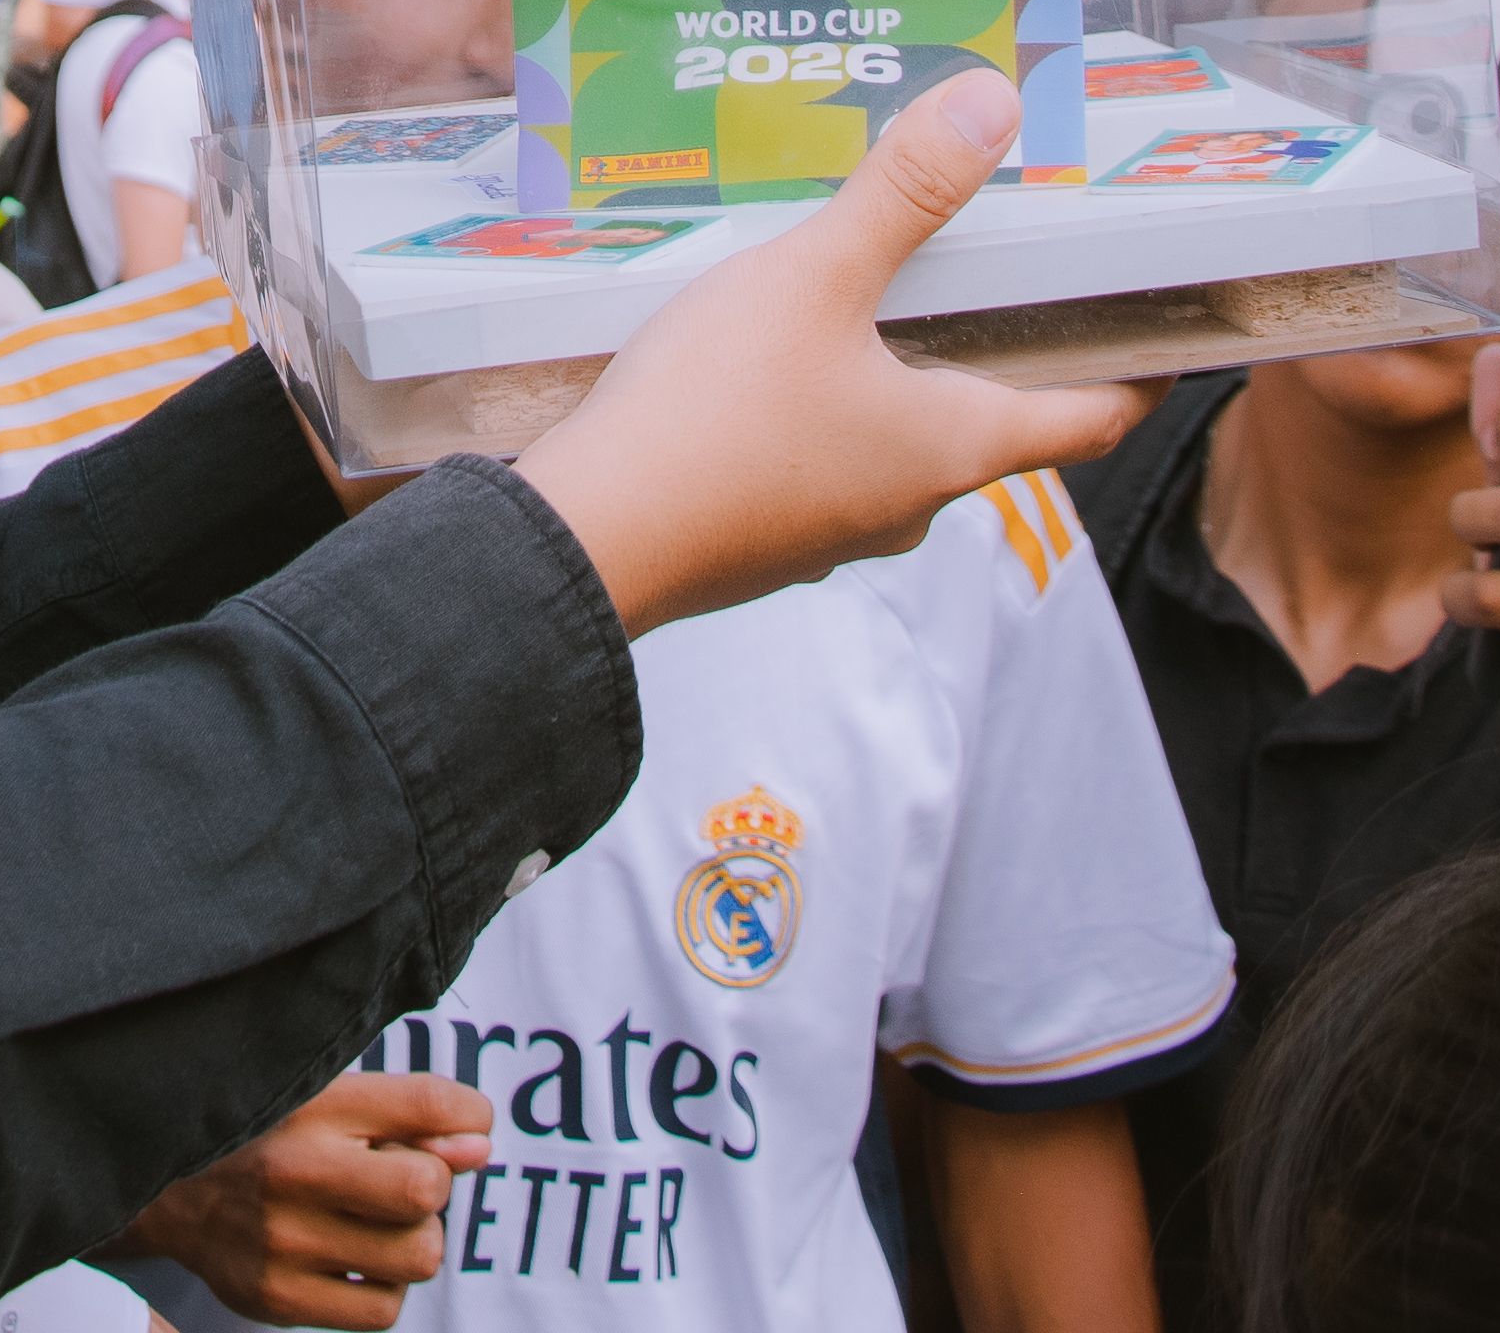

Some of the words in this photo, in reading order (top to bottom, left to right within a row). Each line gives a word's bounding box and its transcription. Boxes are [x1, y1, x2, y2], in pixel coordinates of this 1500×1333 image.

[674, 11, 816, 38] WORLD
[824, 8, 901, 36] CUP
[674, 42, 902, 91] 2026
[616, 153, 703, 171] PANINI
[440, 1163, 684, 1283] ETTER
